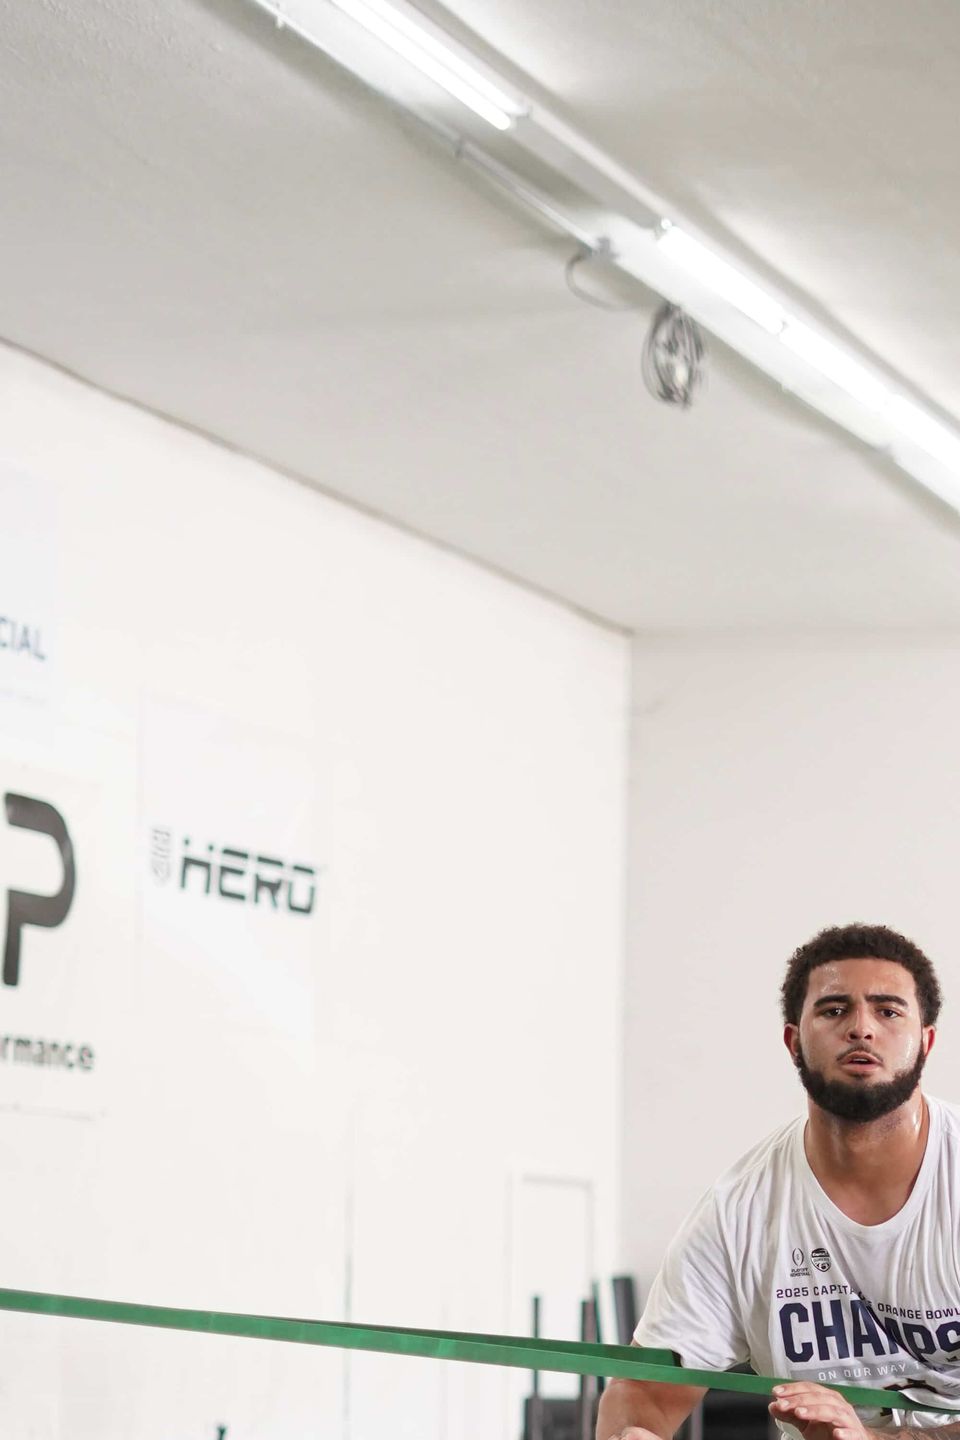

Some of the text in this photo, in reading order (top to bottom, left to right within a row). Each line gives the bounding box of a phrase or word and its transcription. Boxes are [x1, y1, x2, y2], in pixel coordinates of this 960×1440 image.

[180, 837, 316, 914] HERO
[776, 1286, 809, 1299] 2025
[813, 1284, 857, 1297] CAPITA
[877, 1303, 922, 1320] ORANGE
[818, 1370, 837, 1381] ON
[844, 1367, 872, 1379] OUR
[877, 1363, 906, 1376] WAY
